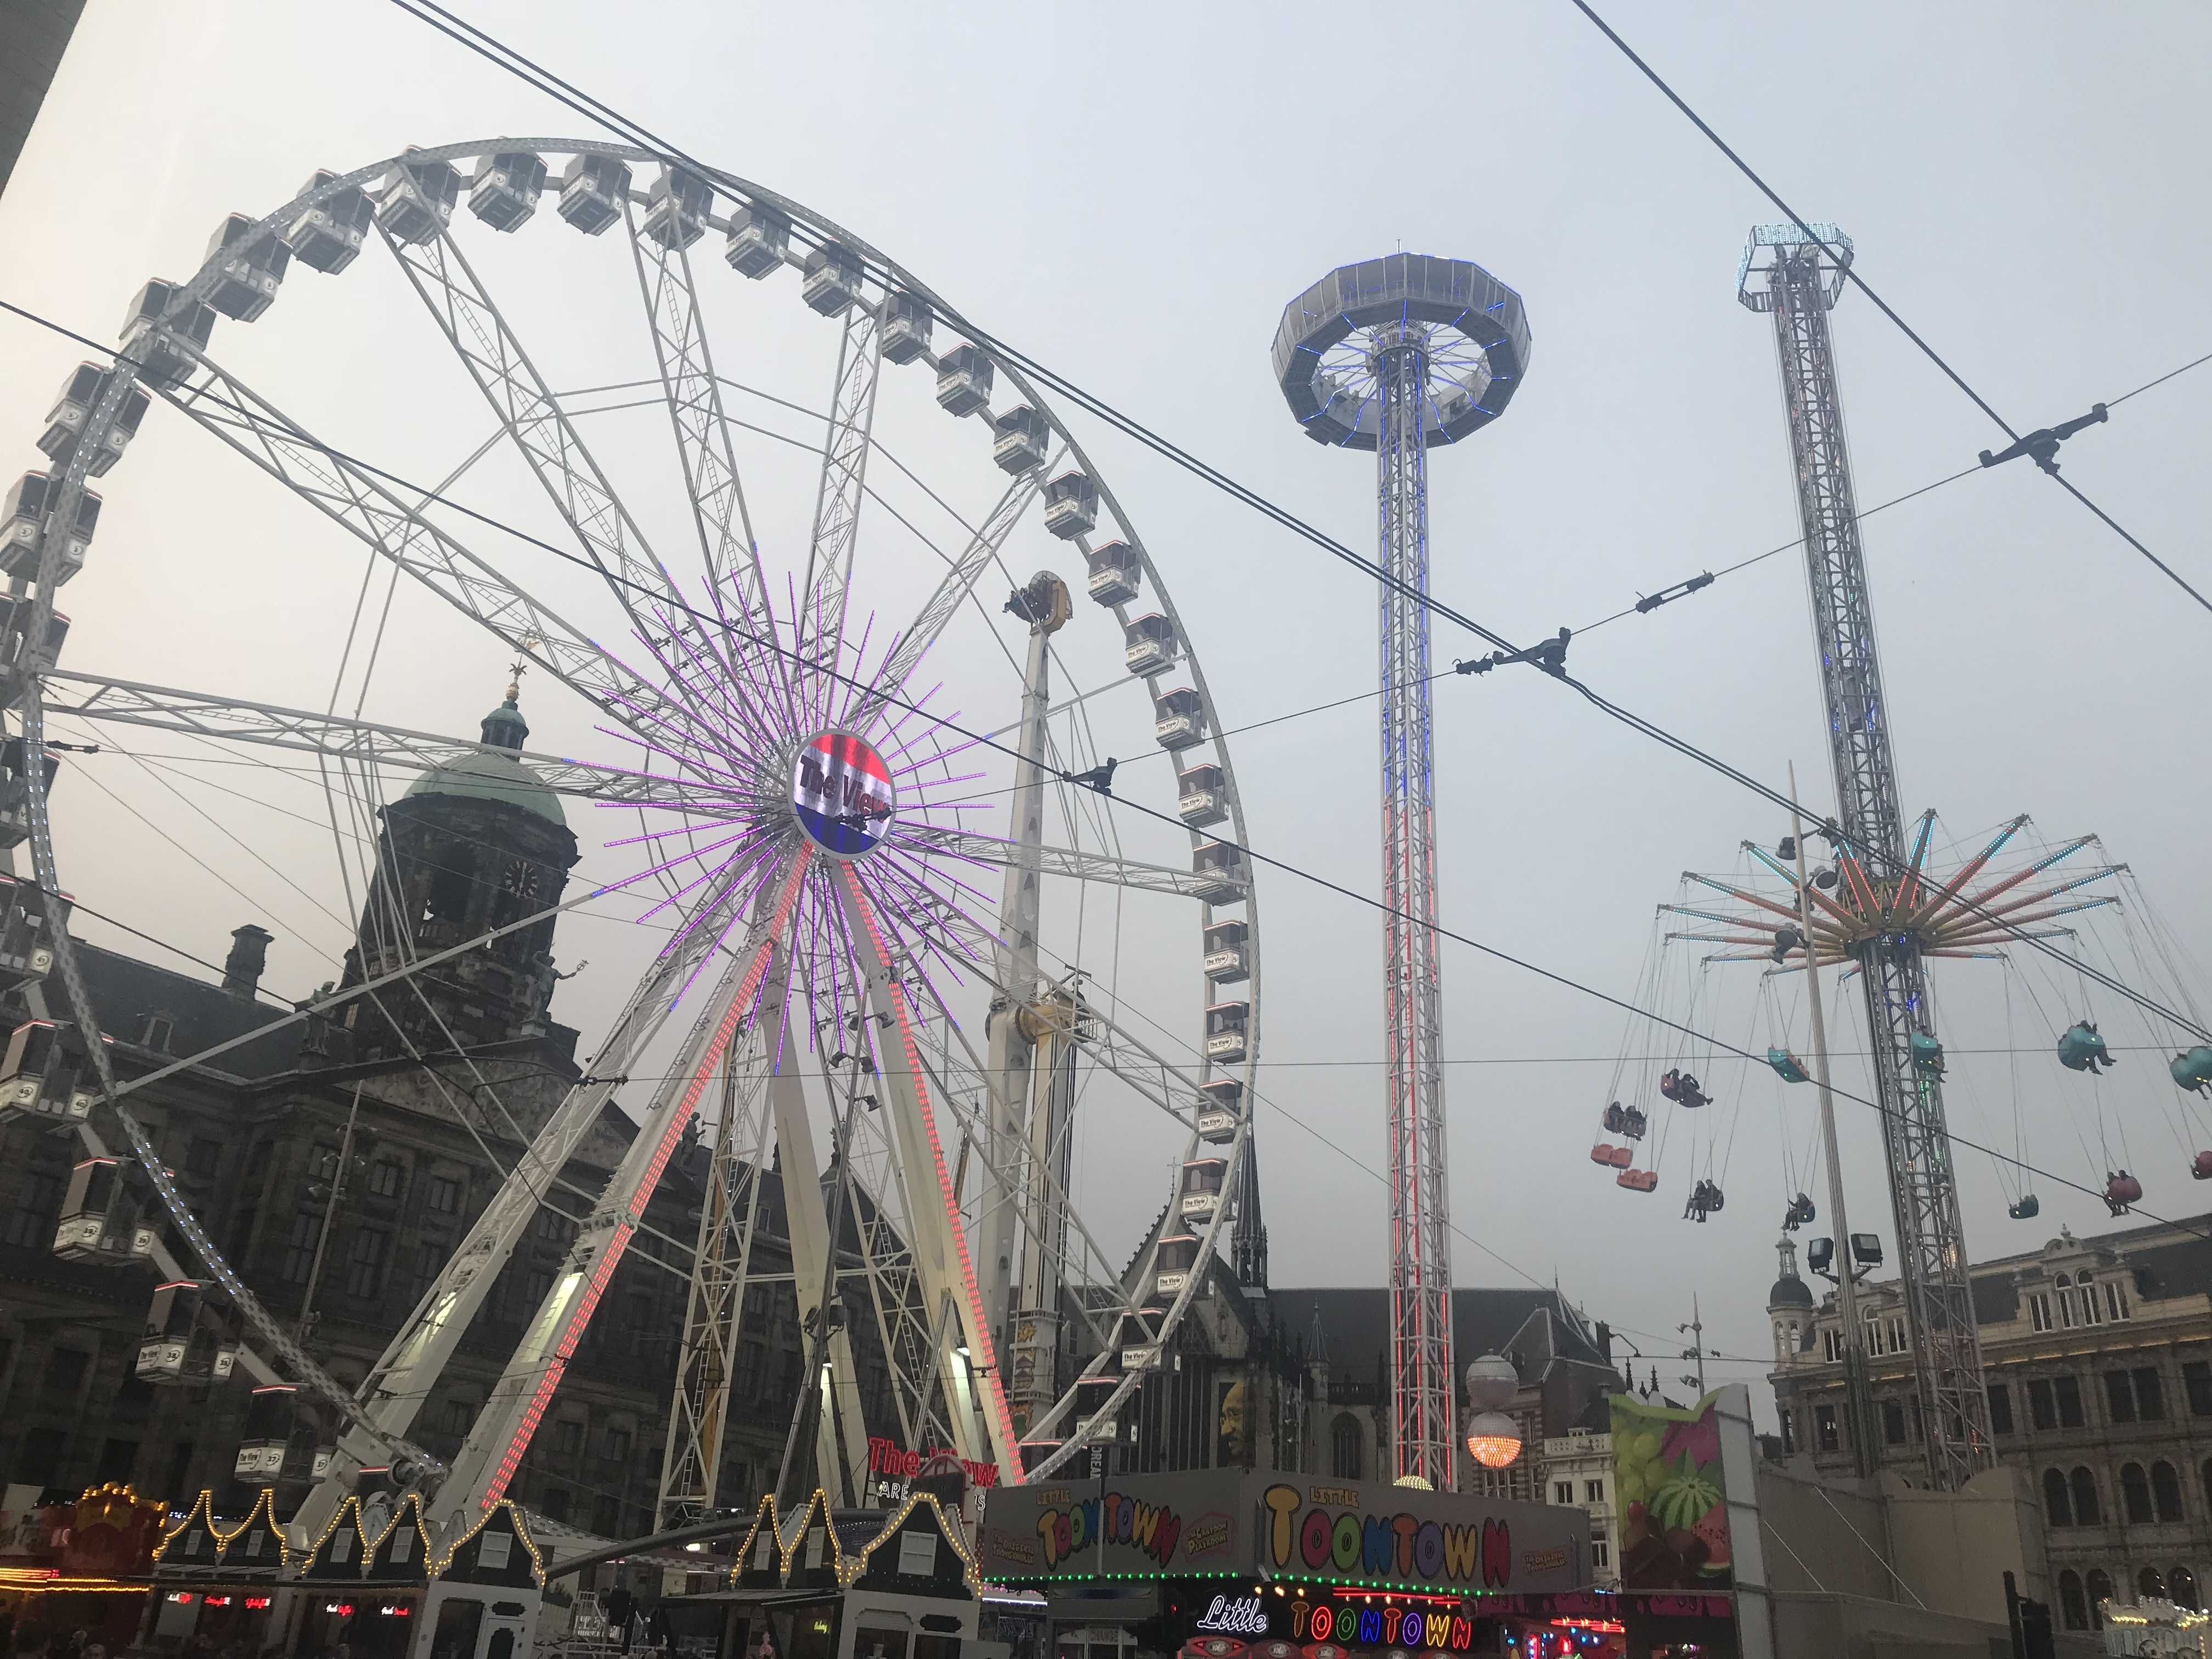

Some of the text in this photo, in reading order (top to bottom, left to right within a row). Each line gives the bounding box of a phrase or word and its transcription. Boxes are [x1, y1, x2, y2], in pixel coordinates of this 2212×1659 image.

[1166, 721, 1177, 729] View
[800, 754, 835, 799] The
[869, 1437, 921, 1479] The
[878, 1481, 910, 1500] ARE
[1035, 1488, 1071, 1506] LITTLE
[1310, 1486, 1360, 1509] LITTLE
[1265, 1483, 1511, 1588] TOONTOWN
[1197, 1595, 1472, 1650] Little TOONTOWN
